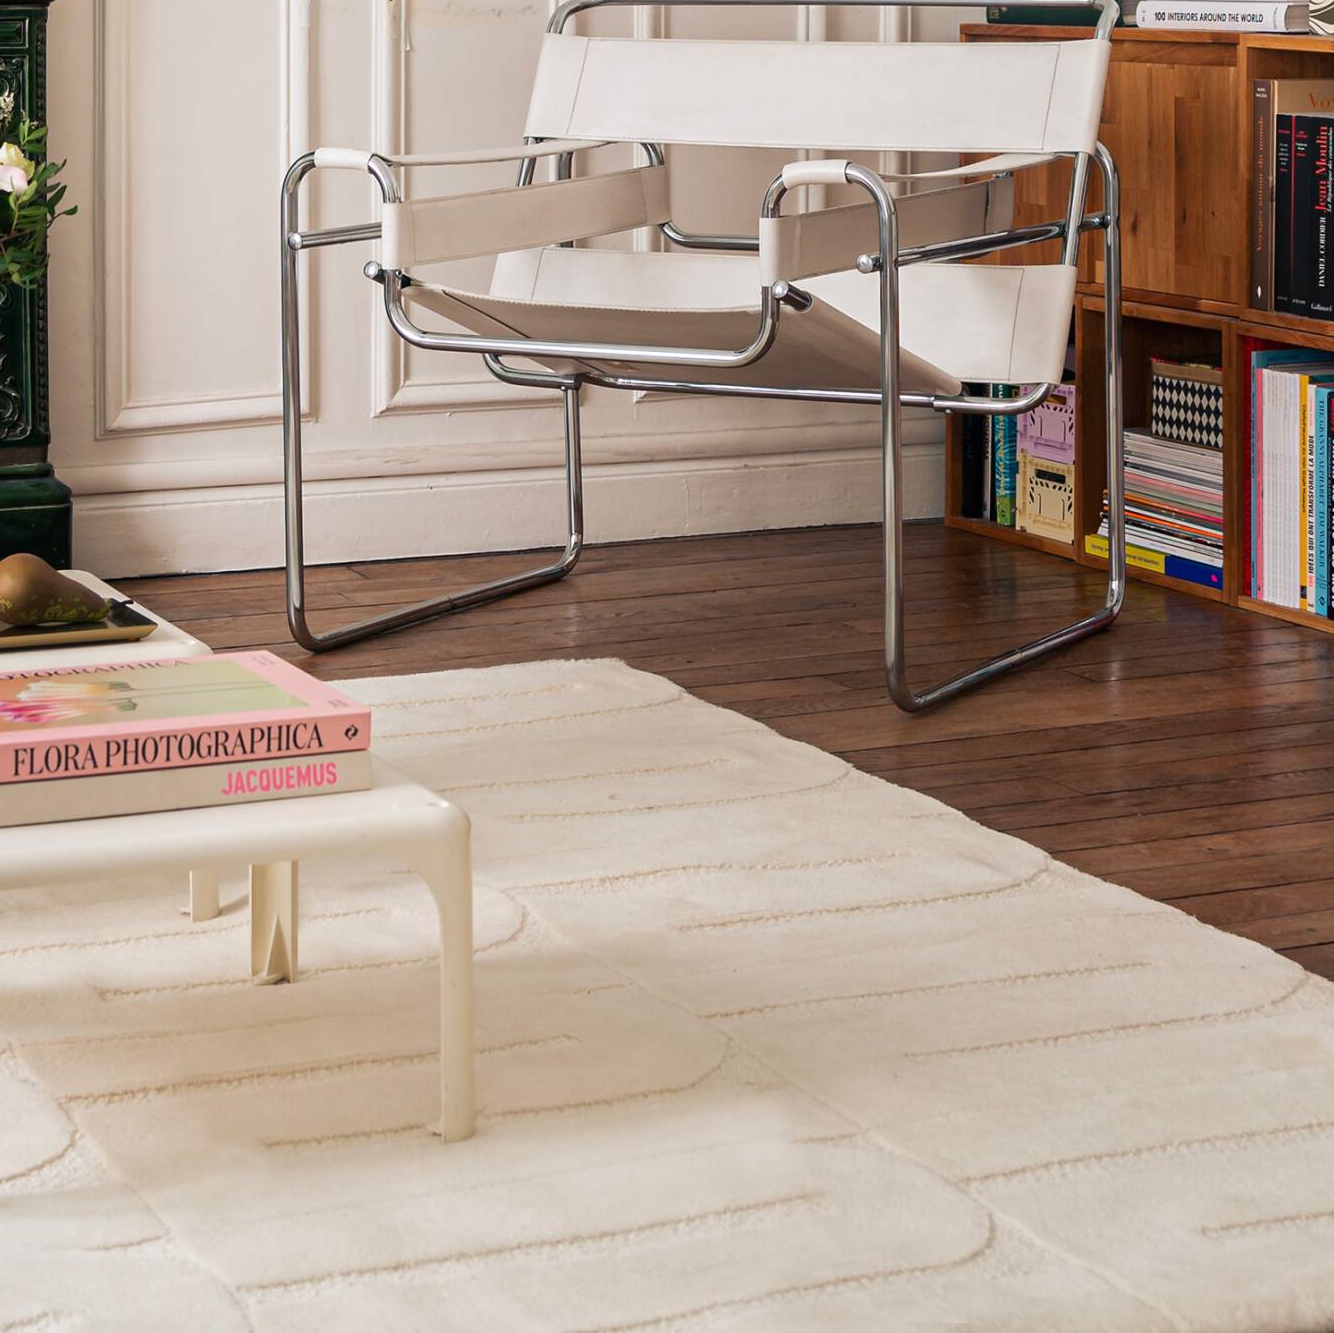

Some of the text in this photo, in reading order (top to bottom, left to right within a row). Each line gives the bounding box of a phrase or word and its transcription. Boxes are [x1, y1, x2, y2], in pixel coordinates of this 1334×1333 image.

[1154, 12, 1264, 23] 100 INTERIORS AROUND THE WORLD
[1315, 126, 1328, 287] DANIEL CORDIER Jean Moulin
[1308, 457, 1315, 468] LA
[12, 722, 324, 776] FLORA PHOTOGRAPHICA
[221, 762, 338, 796] JACQUEMUS
